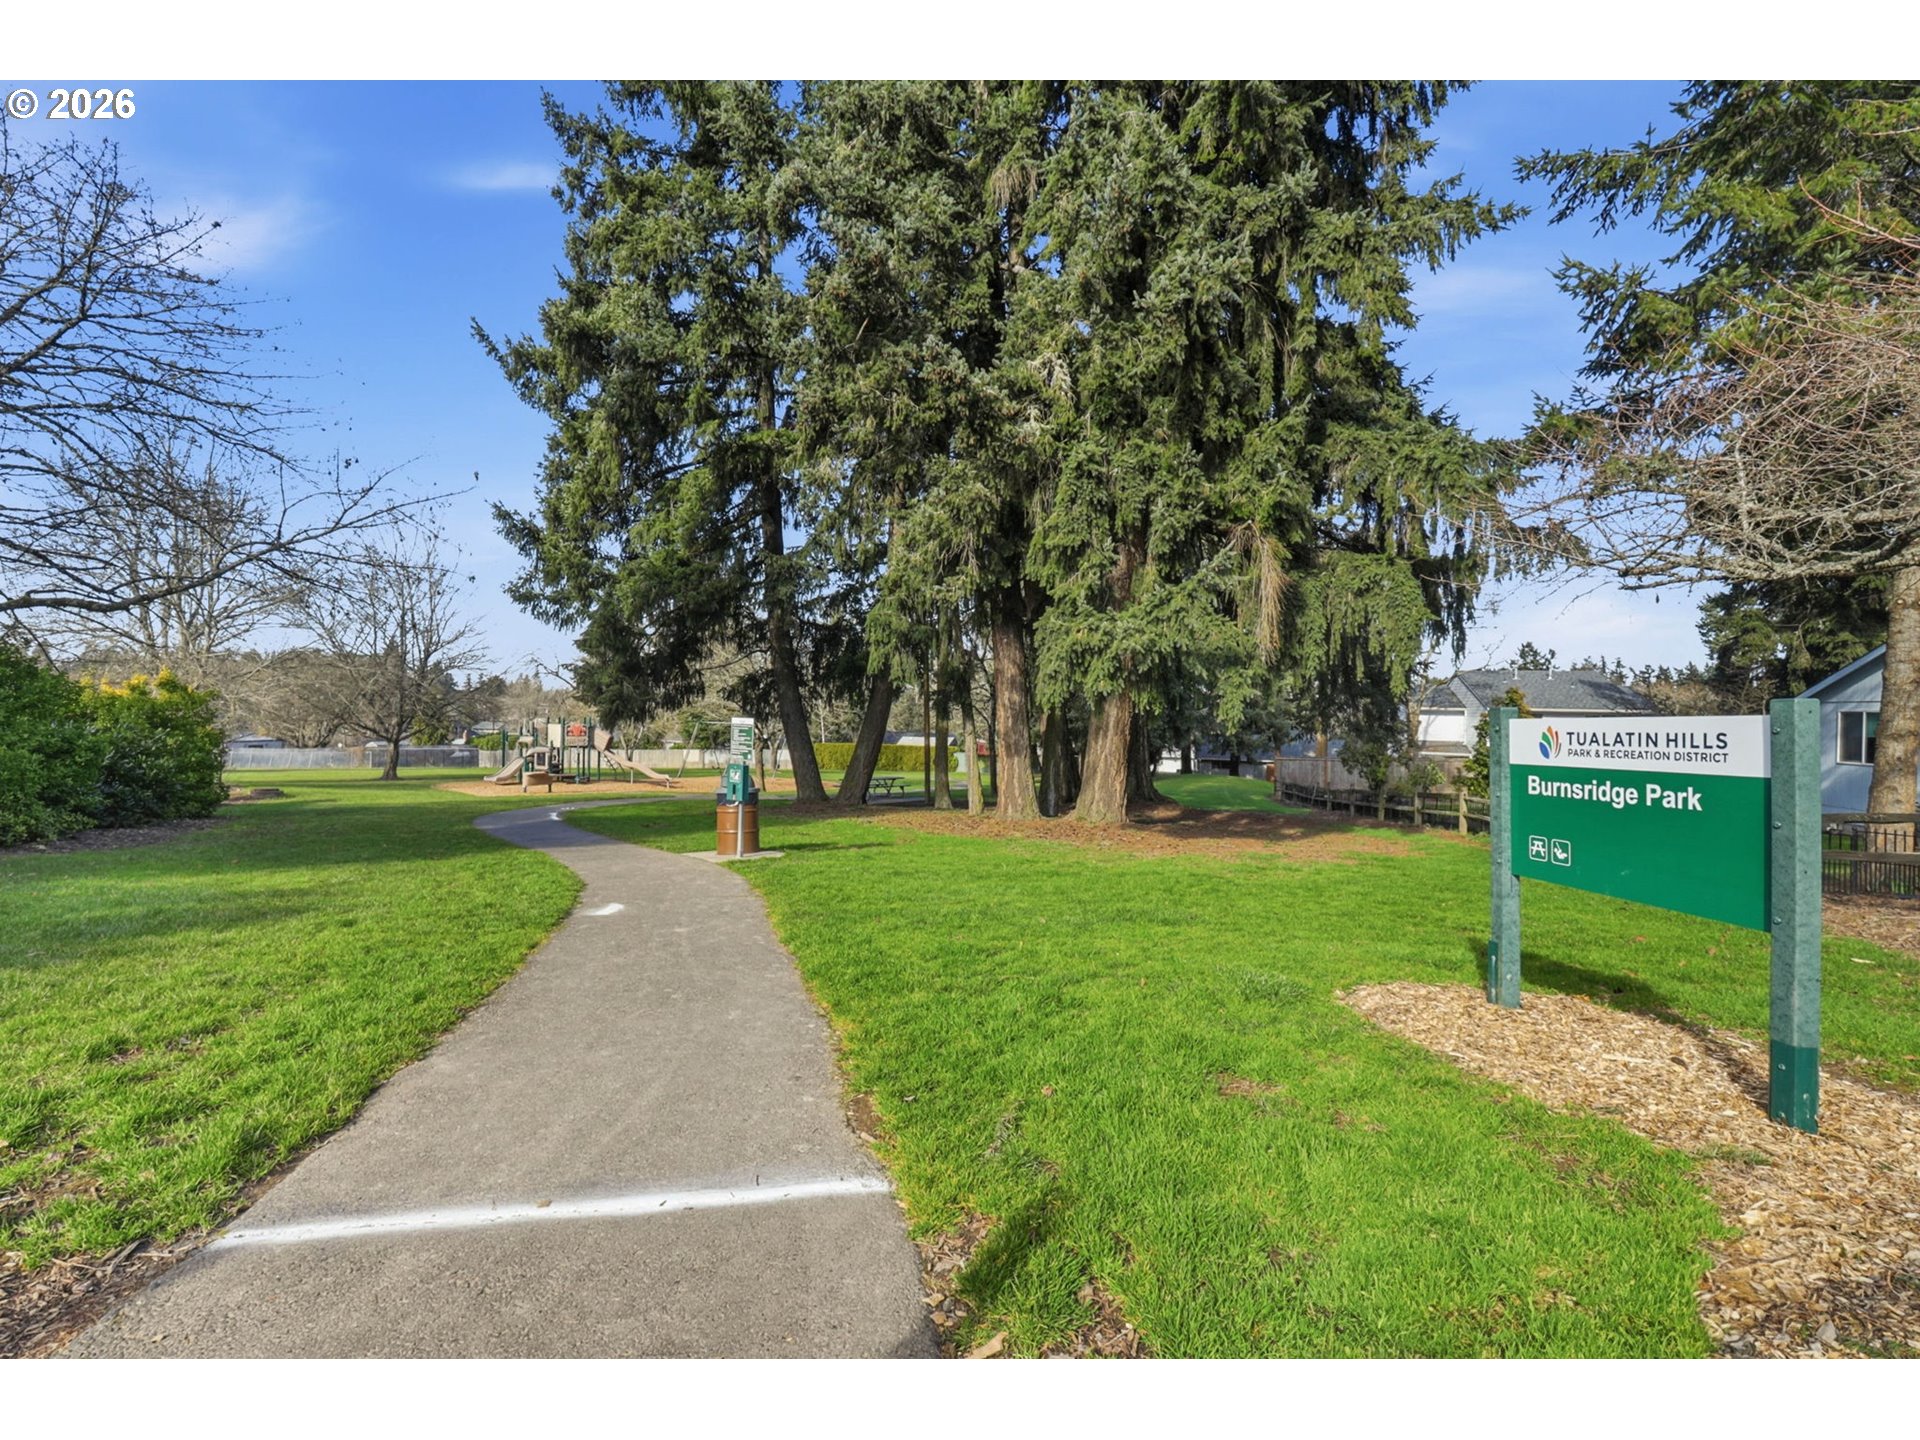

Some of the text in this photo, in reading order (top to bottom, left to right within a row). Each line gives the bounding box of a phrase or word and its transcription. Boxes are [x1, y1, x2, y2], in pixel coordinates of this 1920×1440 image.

[1566, 731, 1729, 750] TUALATIN HILLS
[1567, 748, 1729, 764] PARK & RECREATION DISTRICT
[1527, 774, 1703, 812] Burnsridge Park
